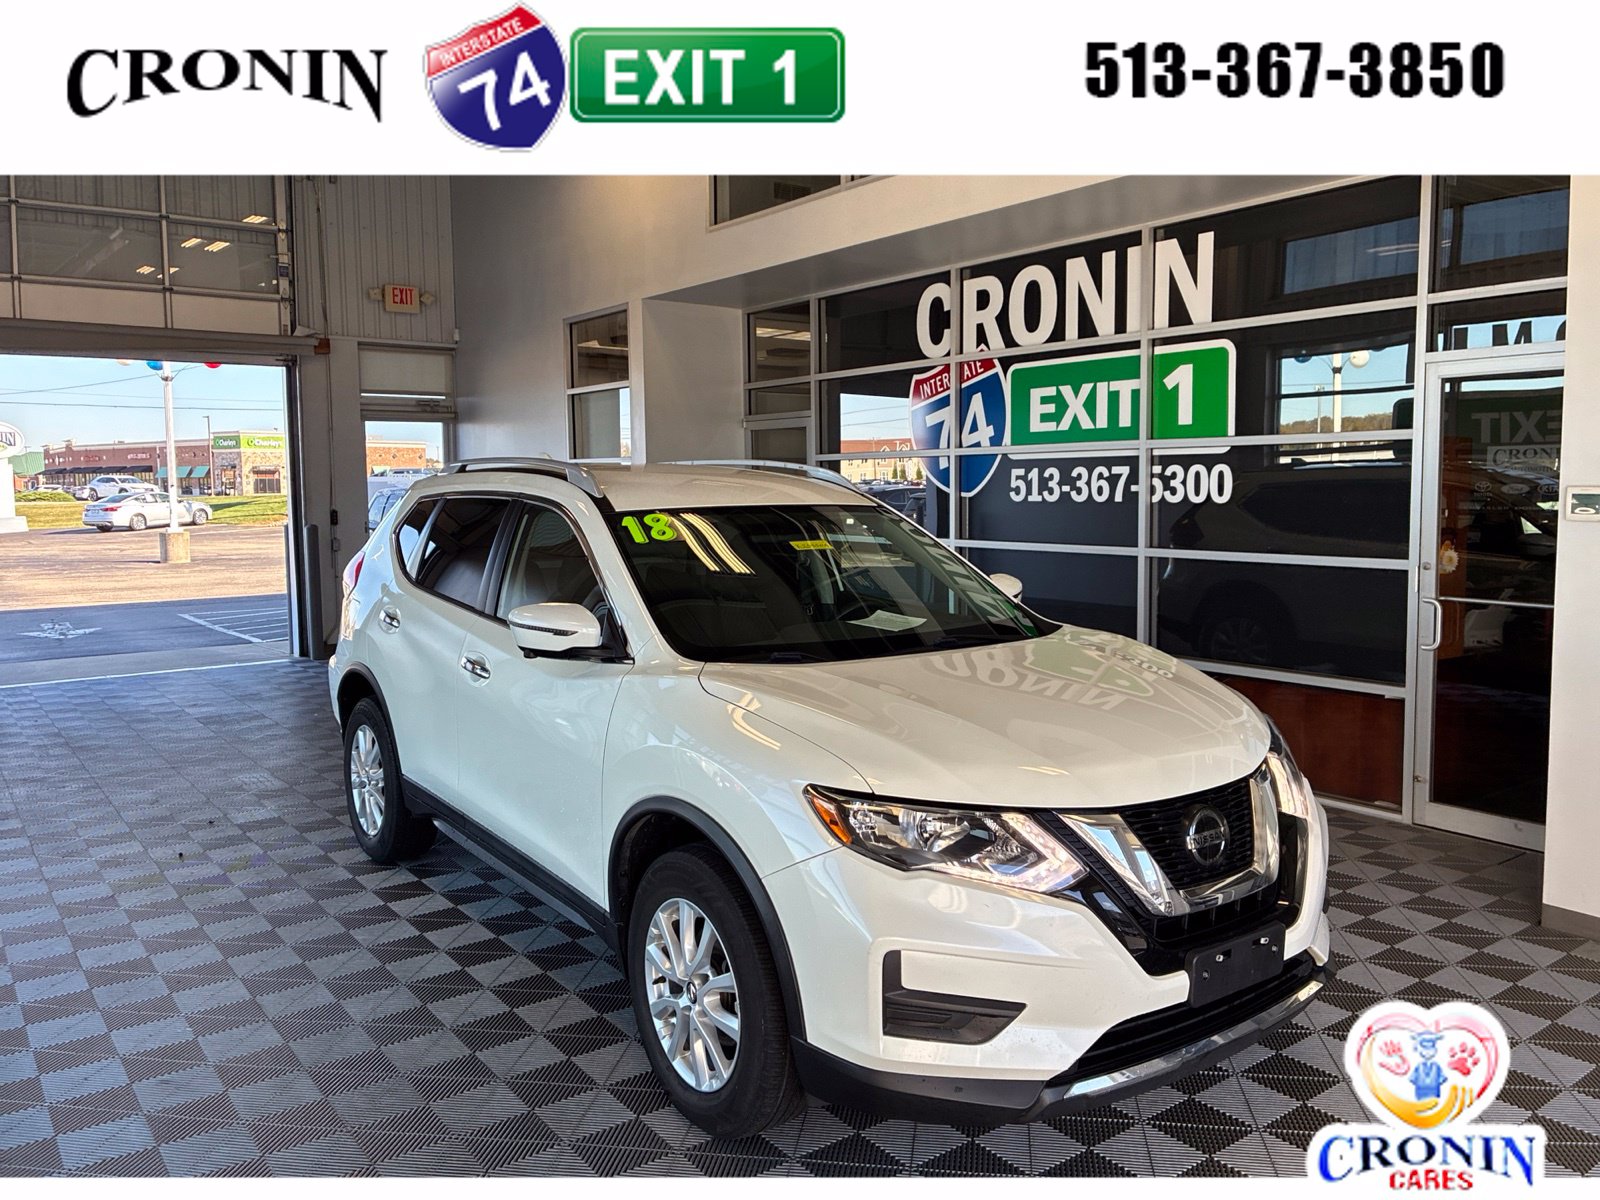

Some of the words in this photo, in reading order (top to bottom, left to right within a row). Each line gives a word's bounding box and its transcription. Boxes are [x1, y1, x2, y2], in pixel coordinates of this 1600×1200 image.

[391, 287, 415, 306] EXIT
[916, 231, 1215, 359] CRONIN
[919, 361, 985, 400] INTERATE
[1029, 379, 1141, 433] EXIT
[1162, 364, 1194, 426] 1
[925, 391, 995, 470] 74
[1009, 463, 1234, 504] 513-367-5300
[621, 513, 677, 544] 18
